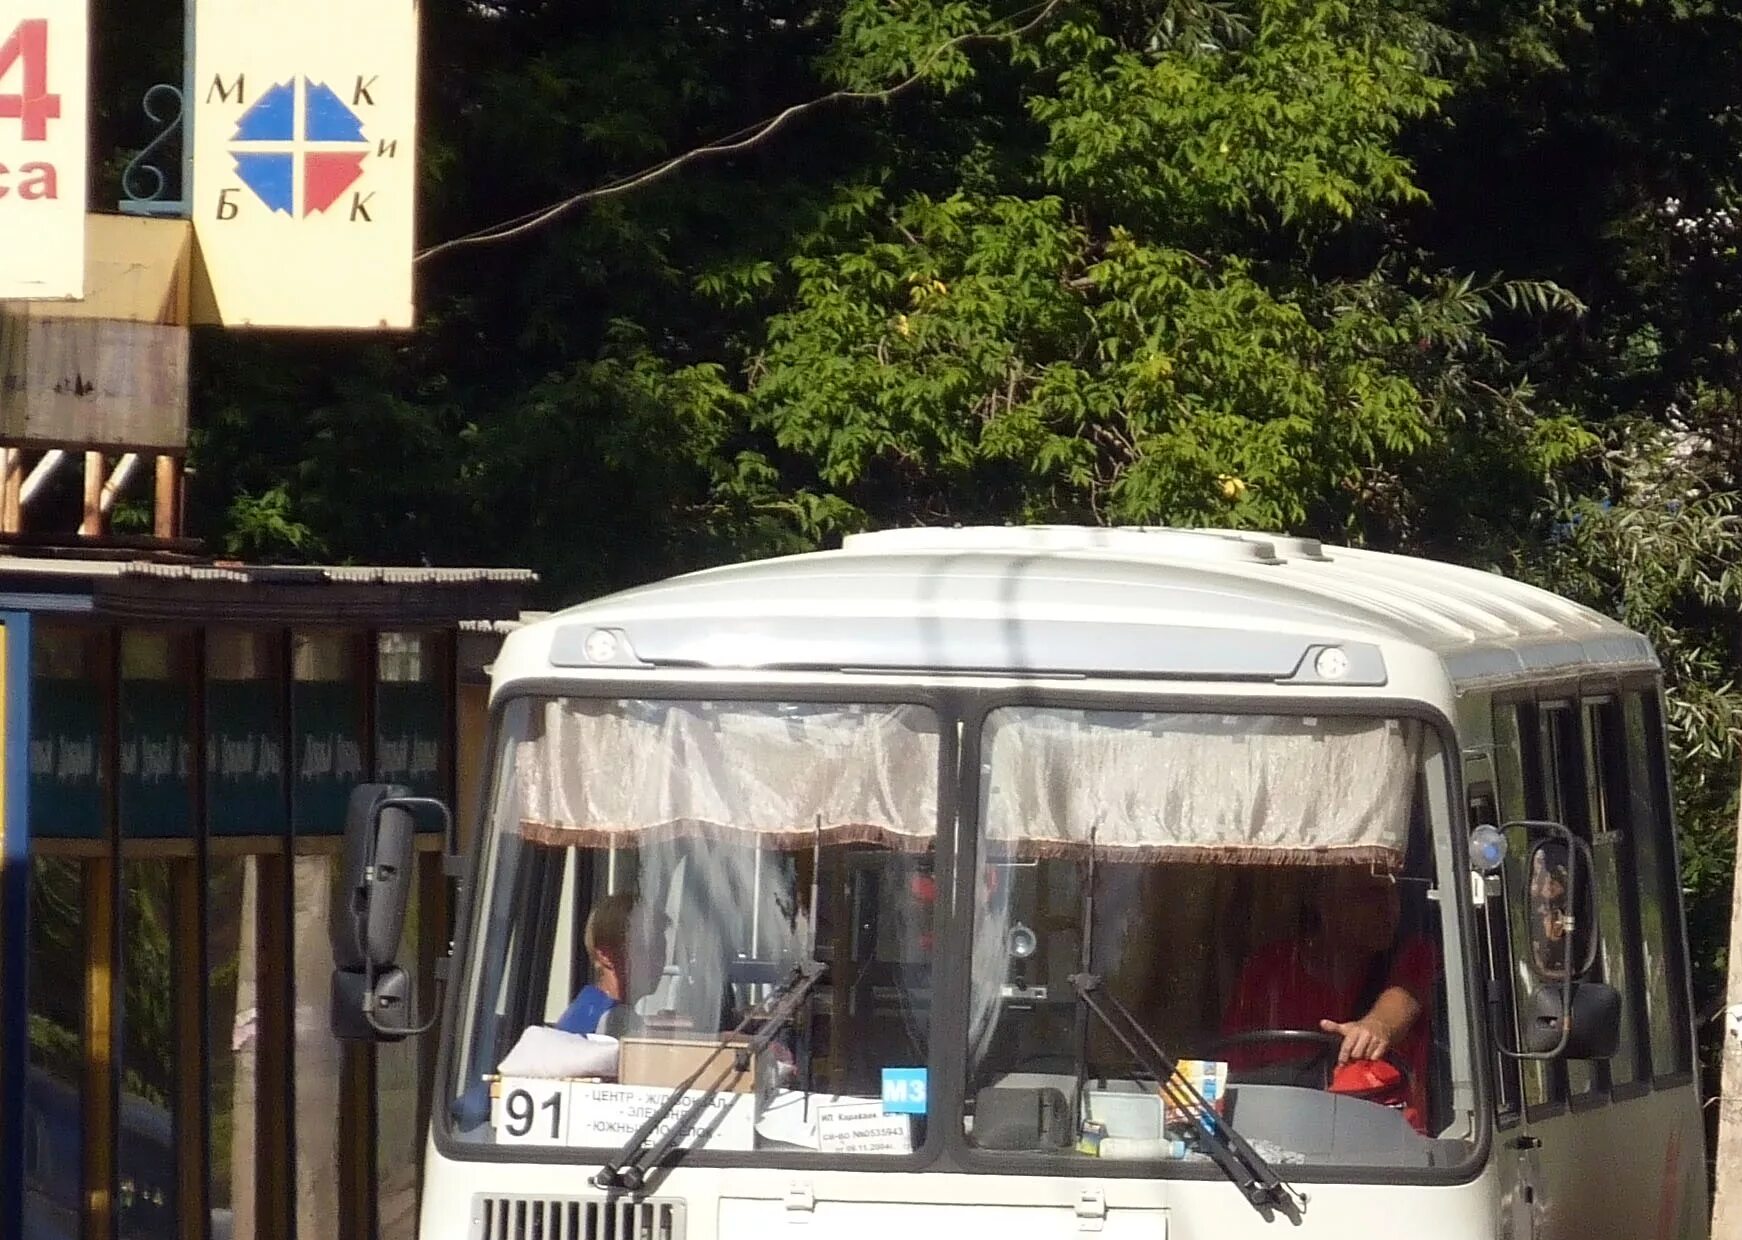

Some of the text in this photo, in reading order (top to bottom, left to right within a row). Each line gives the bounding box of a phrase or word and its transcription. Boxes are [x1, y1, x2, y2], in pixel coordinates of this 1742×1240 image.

[0, 18, 61, 141] 4
[206, 73, 245, 104] М
[0, 160, 59, 200] а
[215, 188, 241, 220] Б
[505, 1088, 562, 1139] 91
[592, 1090, 634, 1102] ЦЕНТР
